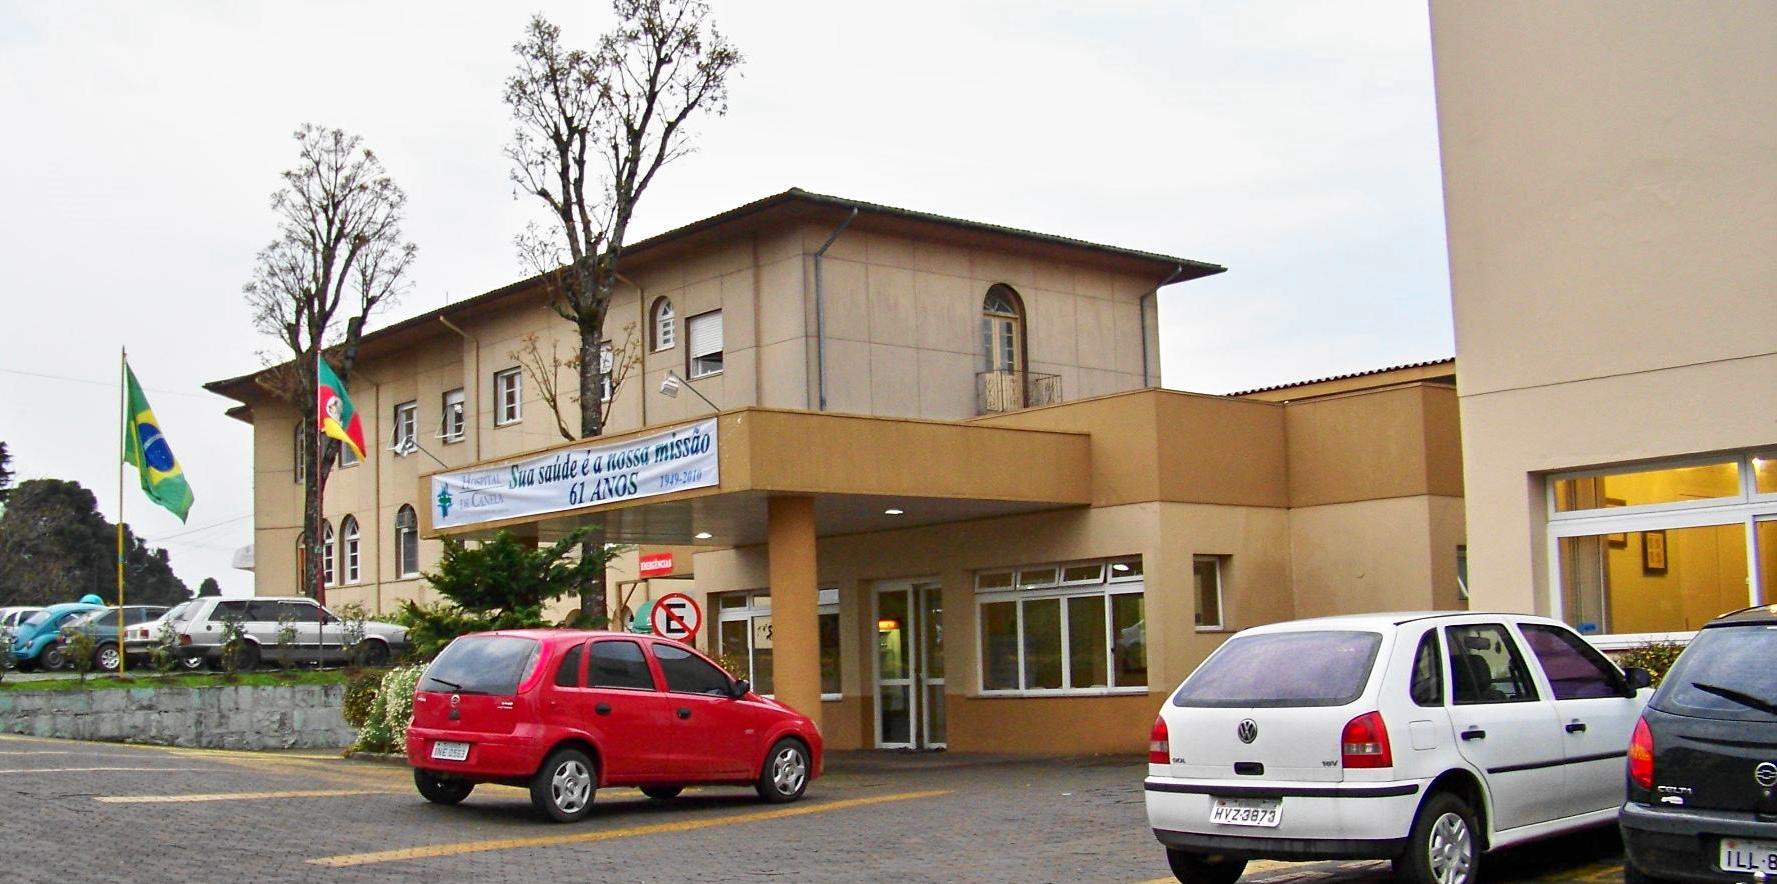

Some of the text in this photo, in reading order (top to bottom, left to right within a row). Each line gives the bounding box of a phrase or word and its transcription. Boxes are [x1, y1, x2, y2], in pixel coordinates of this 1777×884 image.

[509, 427, 711, 489] Sua saúde é a nossa missão
[570, 471, 639, 506] 61 ANOS
[660, 469, 703, 488] 1949-2010
[666, 603, 686, 633] E
[1658, 785, 1693, 794] CELTA
